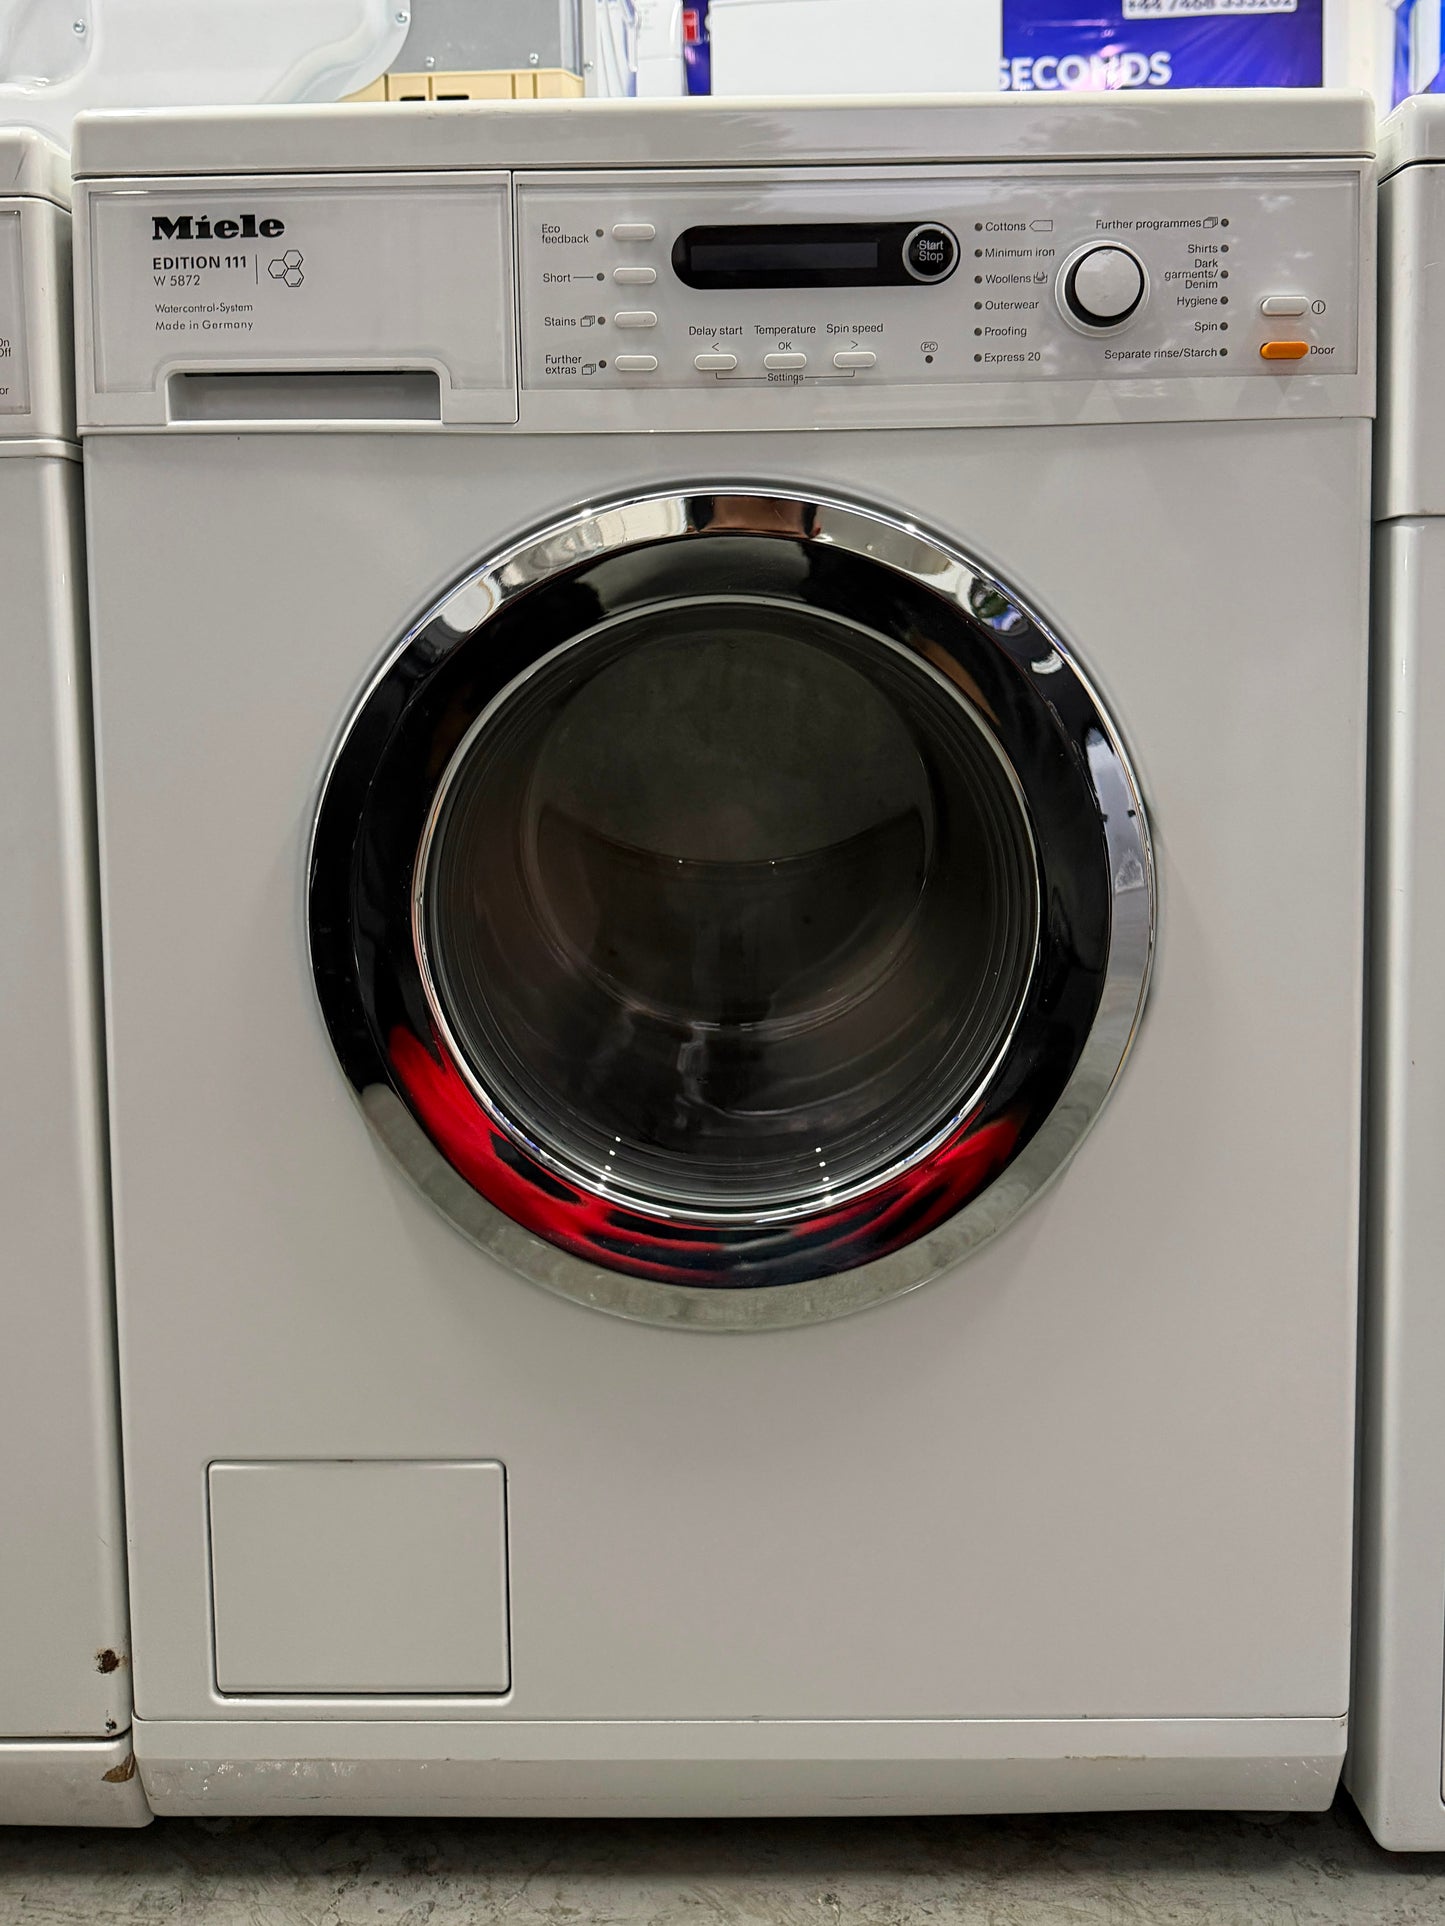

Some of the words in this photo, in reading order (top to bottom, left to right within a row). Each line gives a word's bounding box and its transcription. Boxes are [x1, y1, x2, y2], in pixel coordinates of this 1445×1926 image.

[152, 214, 285, 240] Miele
[541, 223, 561, 234] Eco
[985, 221, 1026, 232] Cottons
[1095, 219, 1133, 230] Further
[1135, 218, 1201, 230] programmes
[541, 233, 590, 244] feedback
[918, 239, 944, 250] Start
[1187, 243, 1218, 254] Shirts
[918, 251, 944, 264] Stop
[985, 248, 1032, 258] Minimum
[1035, 248, 1055, 257] iron
[153, 256, 220, 270] EDITION
[224, 255, 247, 269] 111
[1194, 259, 1218, 268] Dark
[542, 272, 572, 283] Short
[985, 274, 1031, 285] Woollens
[1164, 269, 1218, 281] garments/
[153, 275, 166, 286] W
[170, 275, 201, 287] 5872
[1185, 280, 1218, 289] Denim
[985, 300, 1039, 310] Outerwear
[1176, 296, 1218, 307] Hygiene
[155, 303, 253, 314] Watercontrol-System
[155, 320, 186, 331] Made
[189, 320, 199, 330] in
[202, 319, 254, 331] Germany
[544, 316, 577, 327] Stains
[1194, 321, 1218, 332] Spin
[688, 325, 717, 338] Delay
[719, 325, 743, 336] start
[754, 324, 816, 336] Temperature
[826, 323, 850, 336] Spin
[852, 323, 884, 335] speed
[984, 326, 1027, 337] Proofing
[777, 341, 792, 351] OK
[1310, 345, 1335, 355] Door
[545, 354, 582, 364] Further
[984, 352, 1025, 364] Express
[1028, 351, 1041, 361] 20
[1104, 350, 1151, 361] Separate
[1153, 347, 1218, 359] rinse/Starch
[545, 365, 577, 375] extras
[767, 372, 804, 385] Settings
